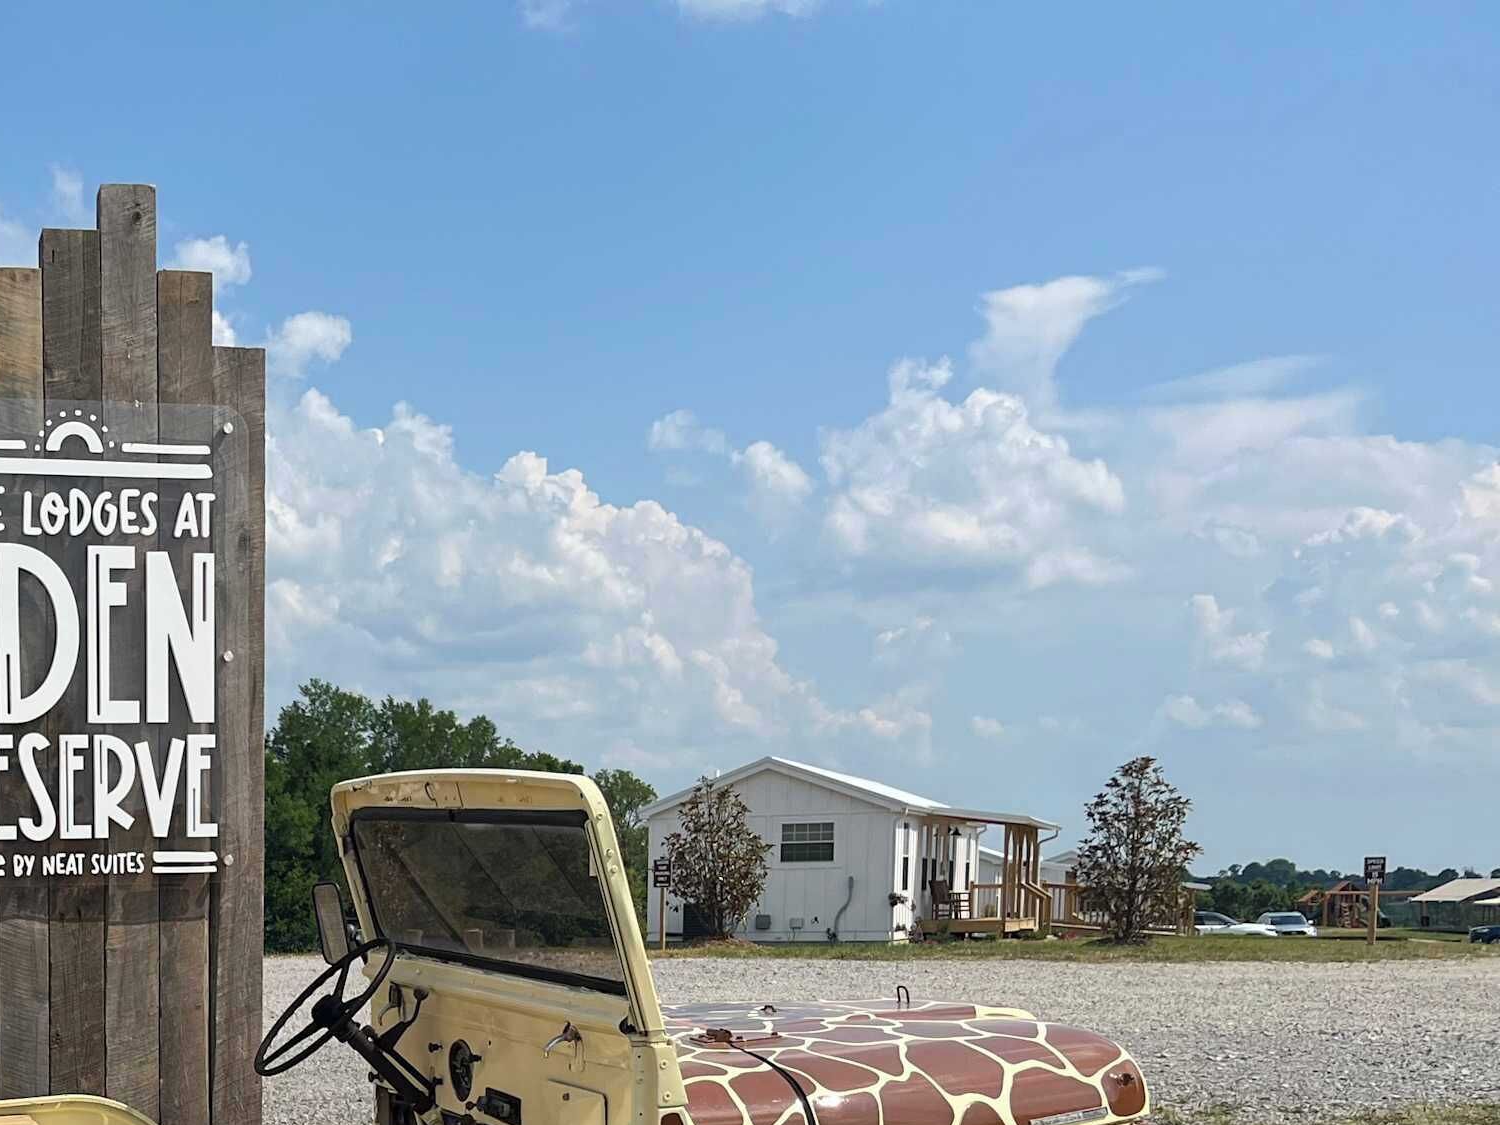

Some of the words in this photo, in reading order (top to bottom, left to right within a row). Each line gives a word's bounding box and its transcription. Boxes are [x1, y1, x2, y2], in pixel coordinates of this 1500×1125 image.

[23, 488, 158, 537] LODGES
[173, 492, 216, 538] AT
[13, 854, 36, 877] BY
[42, 853, 85, 876] NEAT
[91, 852, 145, 874] SUITES
